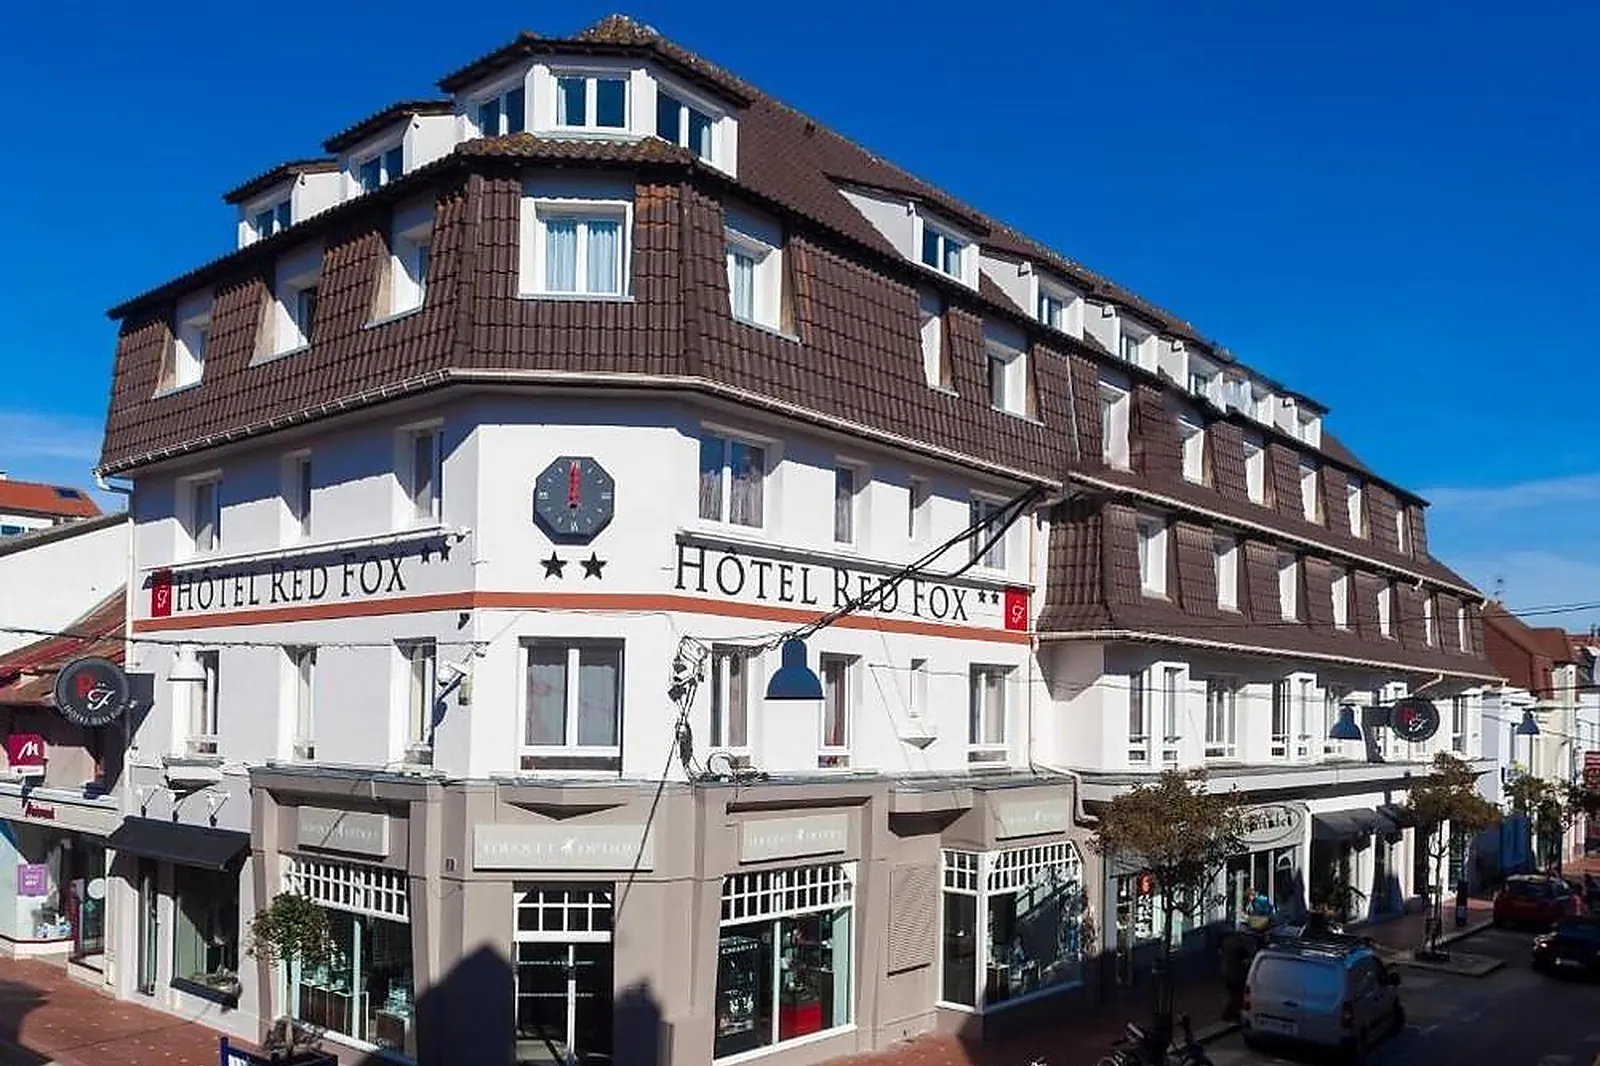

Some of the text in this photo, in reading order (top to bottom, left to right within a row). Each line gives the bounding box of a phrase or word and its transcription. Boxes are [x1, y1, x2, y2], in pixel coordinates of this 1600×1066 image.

[270, 561, 328, 603] RED
[341, 552, 406, 597] FOX
[675, 542, 817, 605] HÔTEL
[833, 566, 898, 613] RED
[912, 575, 968, 621] FOX
